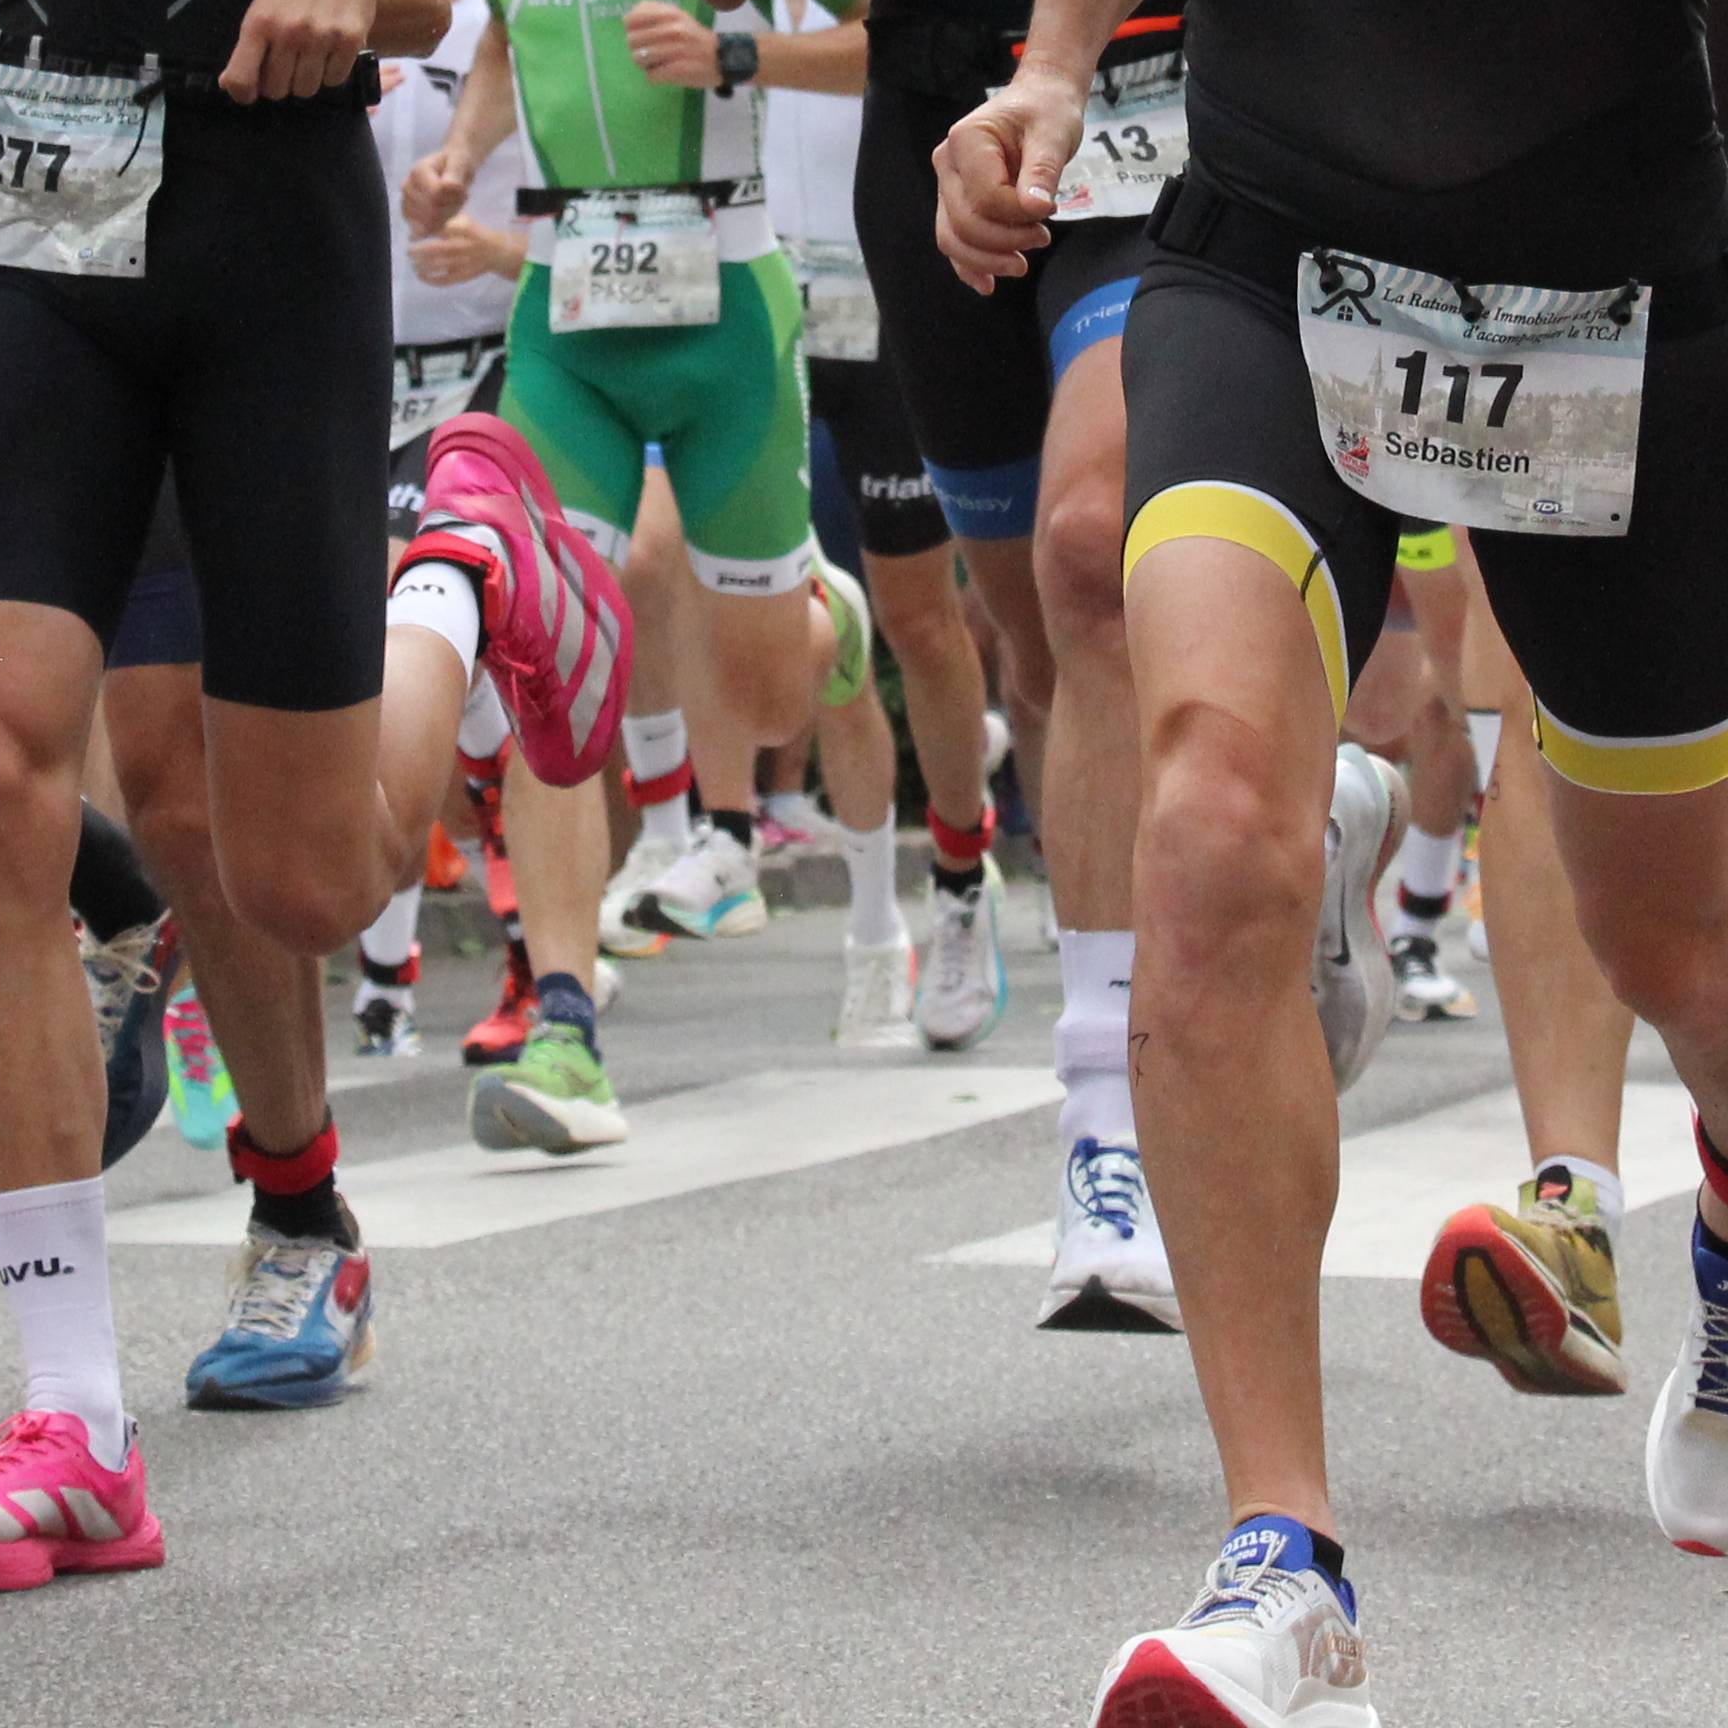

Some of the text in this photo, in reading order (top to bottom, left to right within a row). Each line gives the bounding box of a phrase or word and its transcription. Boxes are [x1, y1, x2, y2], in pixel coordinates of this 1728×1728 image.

[1092, 124, 1159, 163] 13
[591, 243, 660, 276] 292
[1382, 287, 1405, 303] La
[1493, 307, 1570, 327] Immobilier
[1567, 325, 1581, 339] le
[1584, 327, 1623, 342] TCA
[1395, 350, 1524, 428] 117
[1385, 432, 1530, 474] Sebastien
